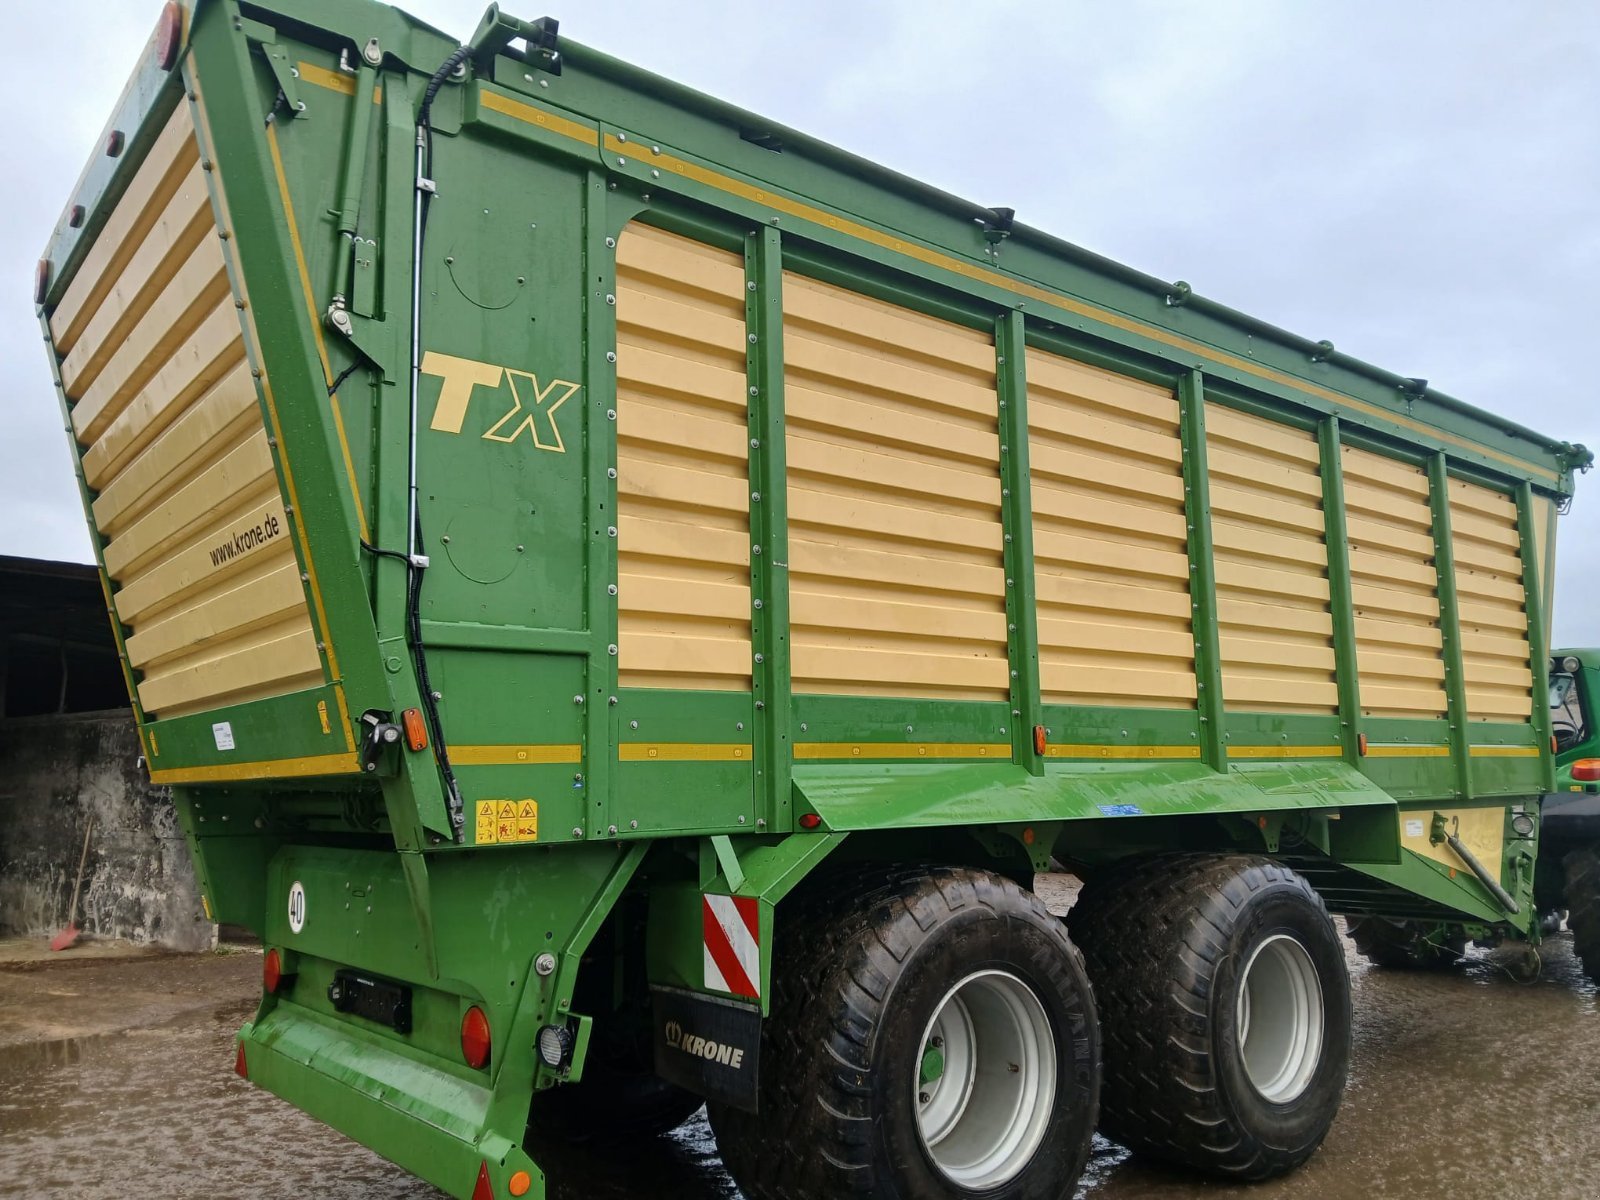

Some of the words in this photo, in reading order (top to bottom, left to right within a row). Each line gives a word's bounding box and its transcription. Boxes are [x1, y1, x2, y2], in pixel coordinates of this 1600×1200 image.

[420, 350, 581, 453] TX
[209, 513, 279, 567] www.krone.de
[290, 890, 303, 925] 40
[681, 1033, 744, 1069] KRONE
